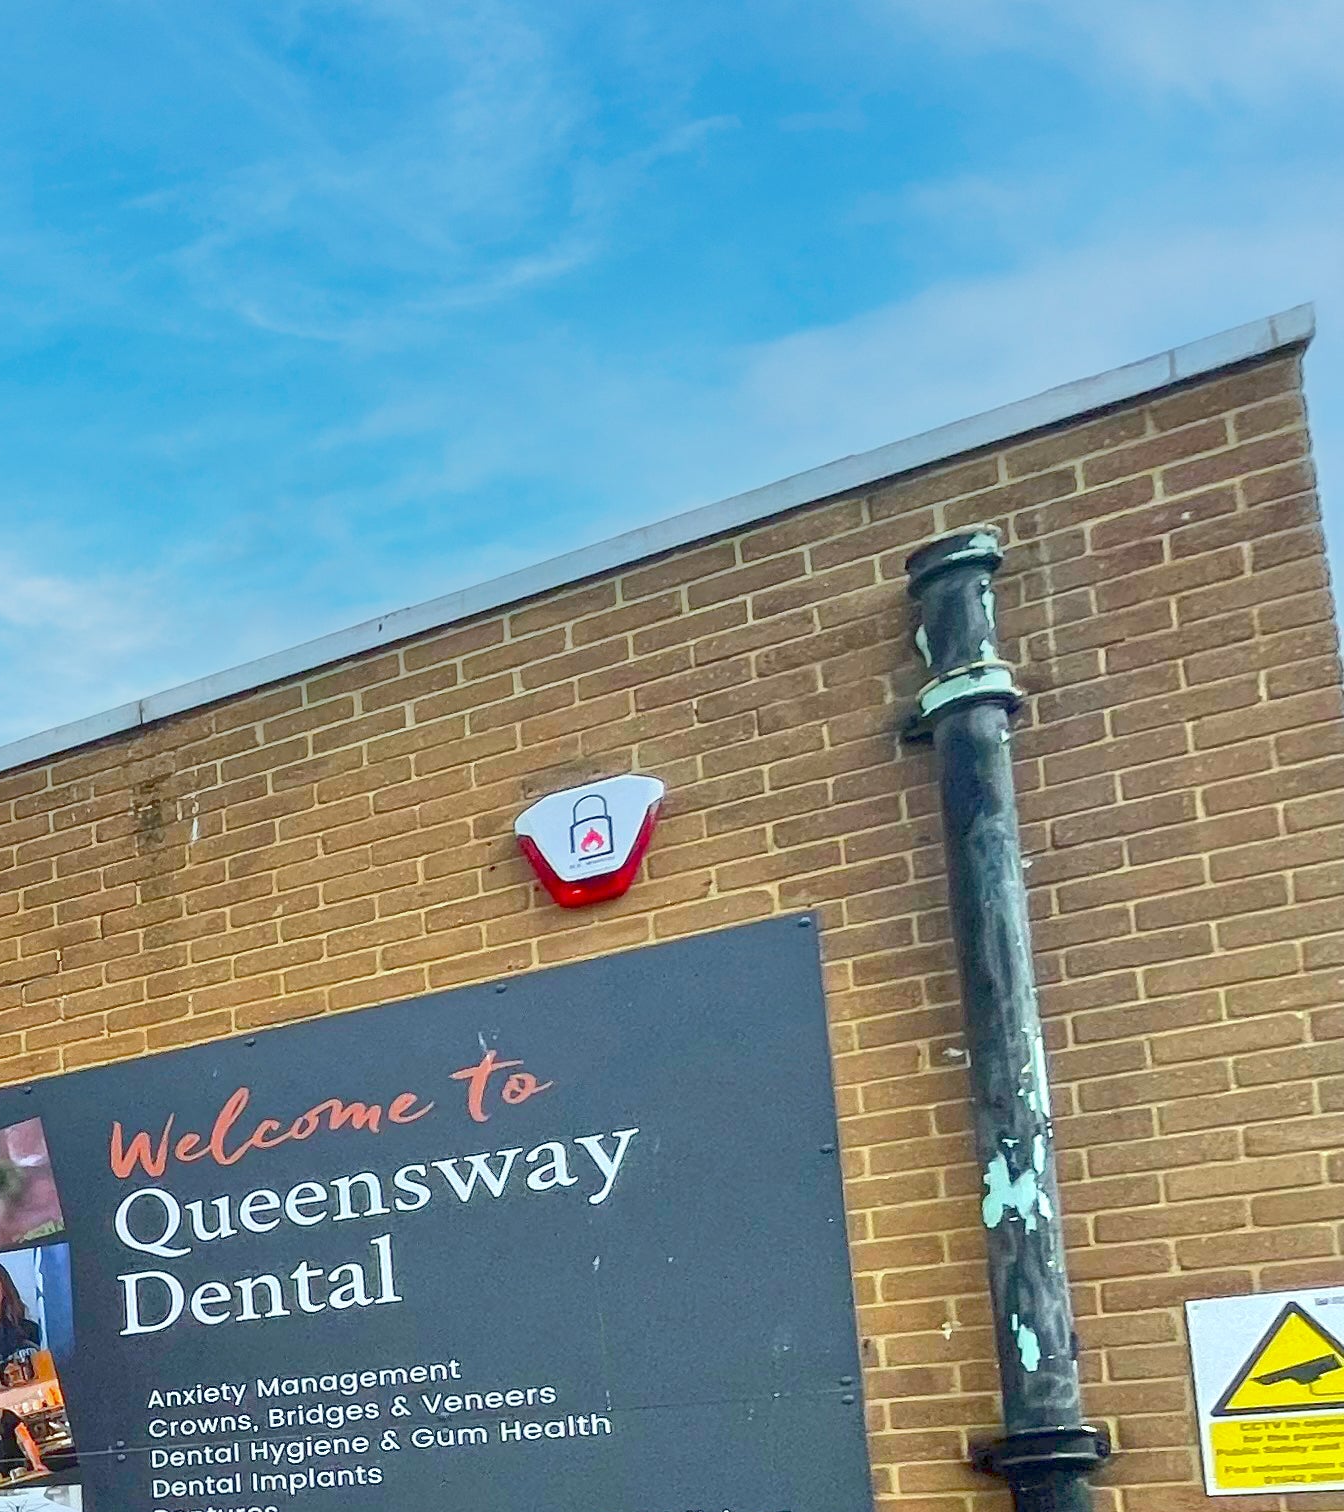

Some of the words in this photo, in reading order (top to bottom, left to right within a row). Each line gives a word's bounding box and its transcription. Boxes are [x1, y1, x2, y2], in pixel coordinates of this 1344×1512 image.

[110, 1087, 433, 1179] Welcome
[449, 1049, 553, 1122] to
[114, 1127, 640, 1258] Queensway
[118, 1234, 404, 1336] Dental
[148, 1382, 247, 1409] Anxiety
[257, 1359, 461, 1395] Management
[149, 1413, 259, 1438] Crowns,
[269, 1401, 379, 1428] Bridges
[390, 1396, 411, 1417] &
[421, 1385, 557, 1415] Veneers
[1240, 1421, 1281, 1431] CCTV
[150, 1443, 240, 1468] Dental
[251, 1435, 370, 1465] Hygiene
[381, 1430, 400, 1451] &
[412, 1425, 488, 1449] Gum
[500, 1413, 611, 1442] Health
[152, 1473, 242, 1498] Dental
[251, 1464, 382, 1495] Implants
